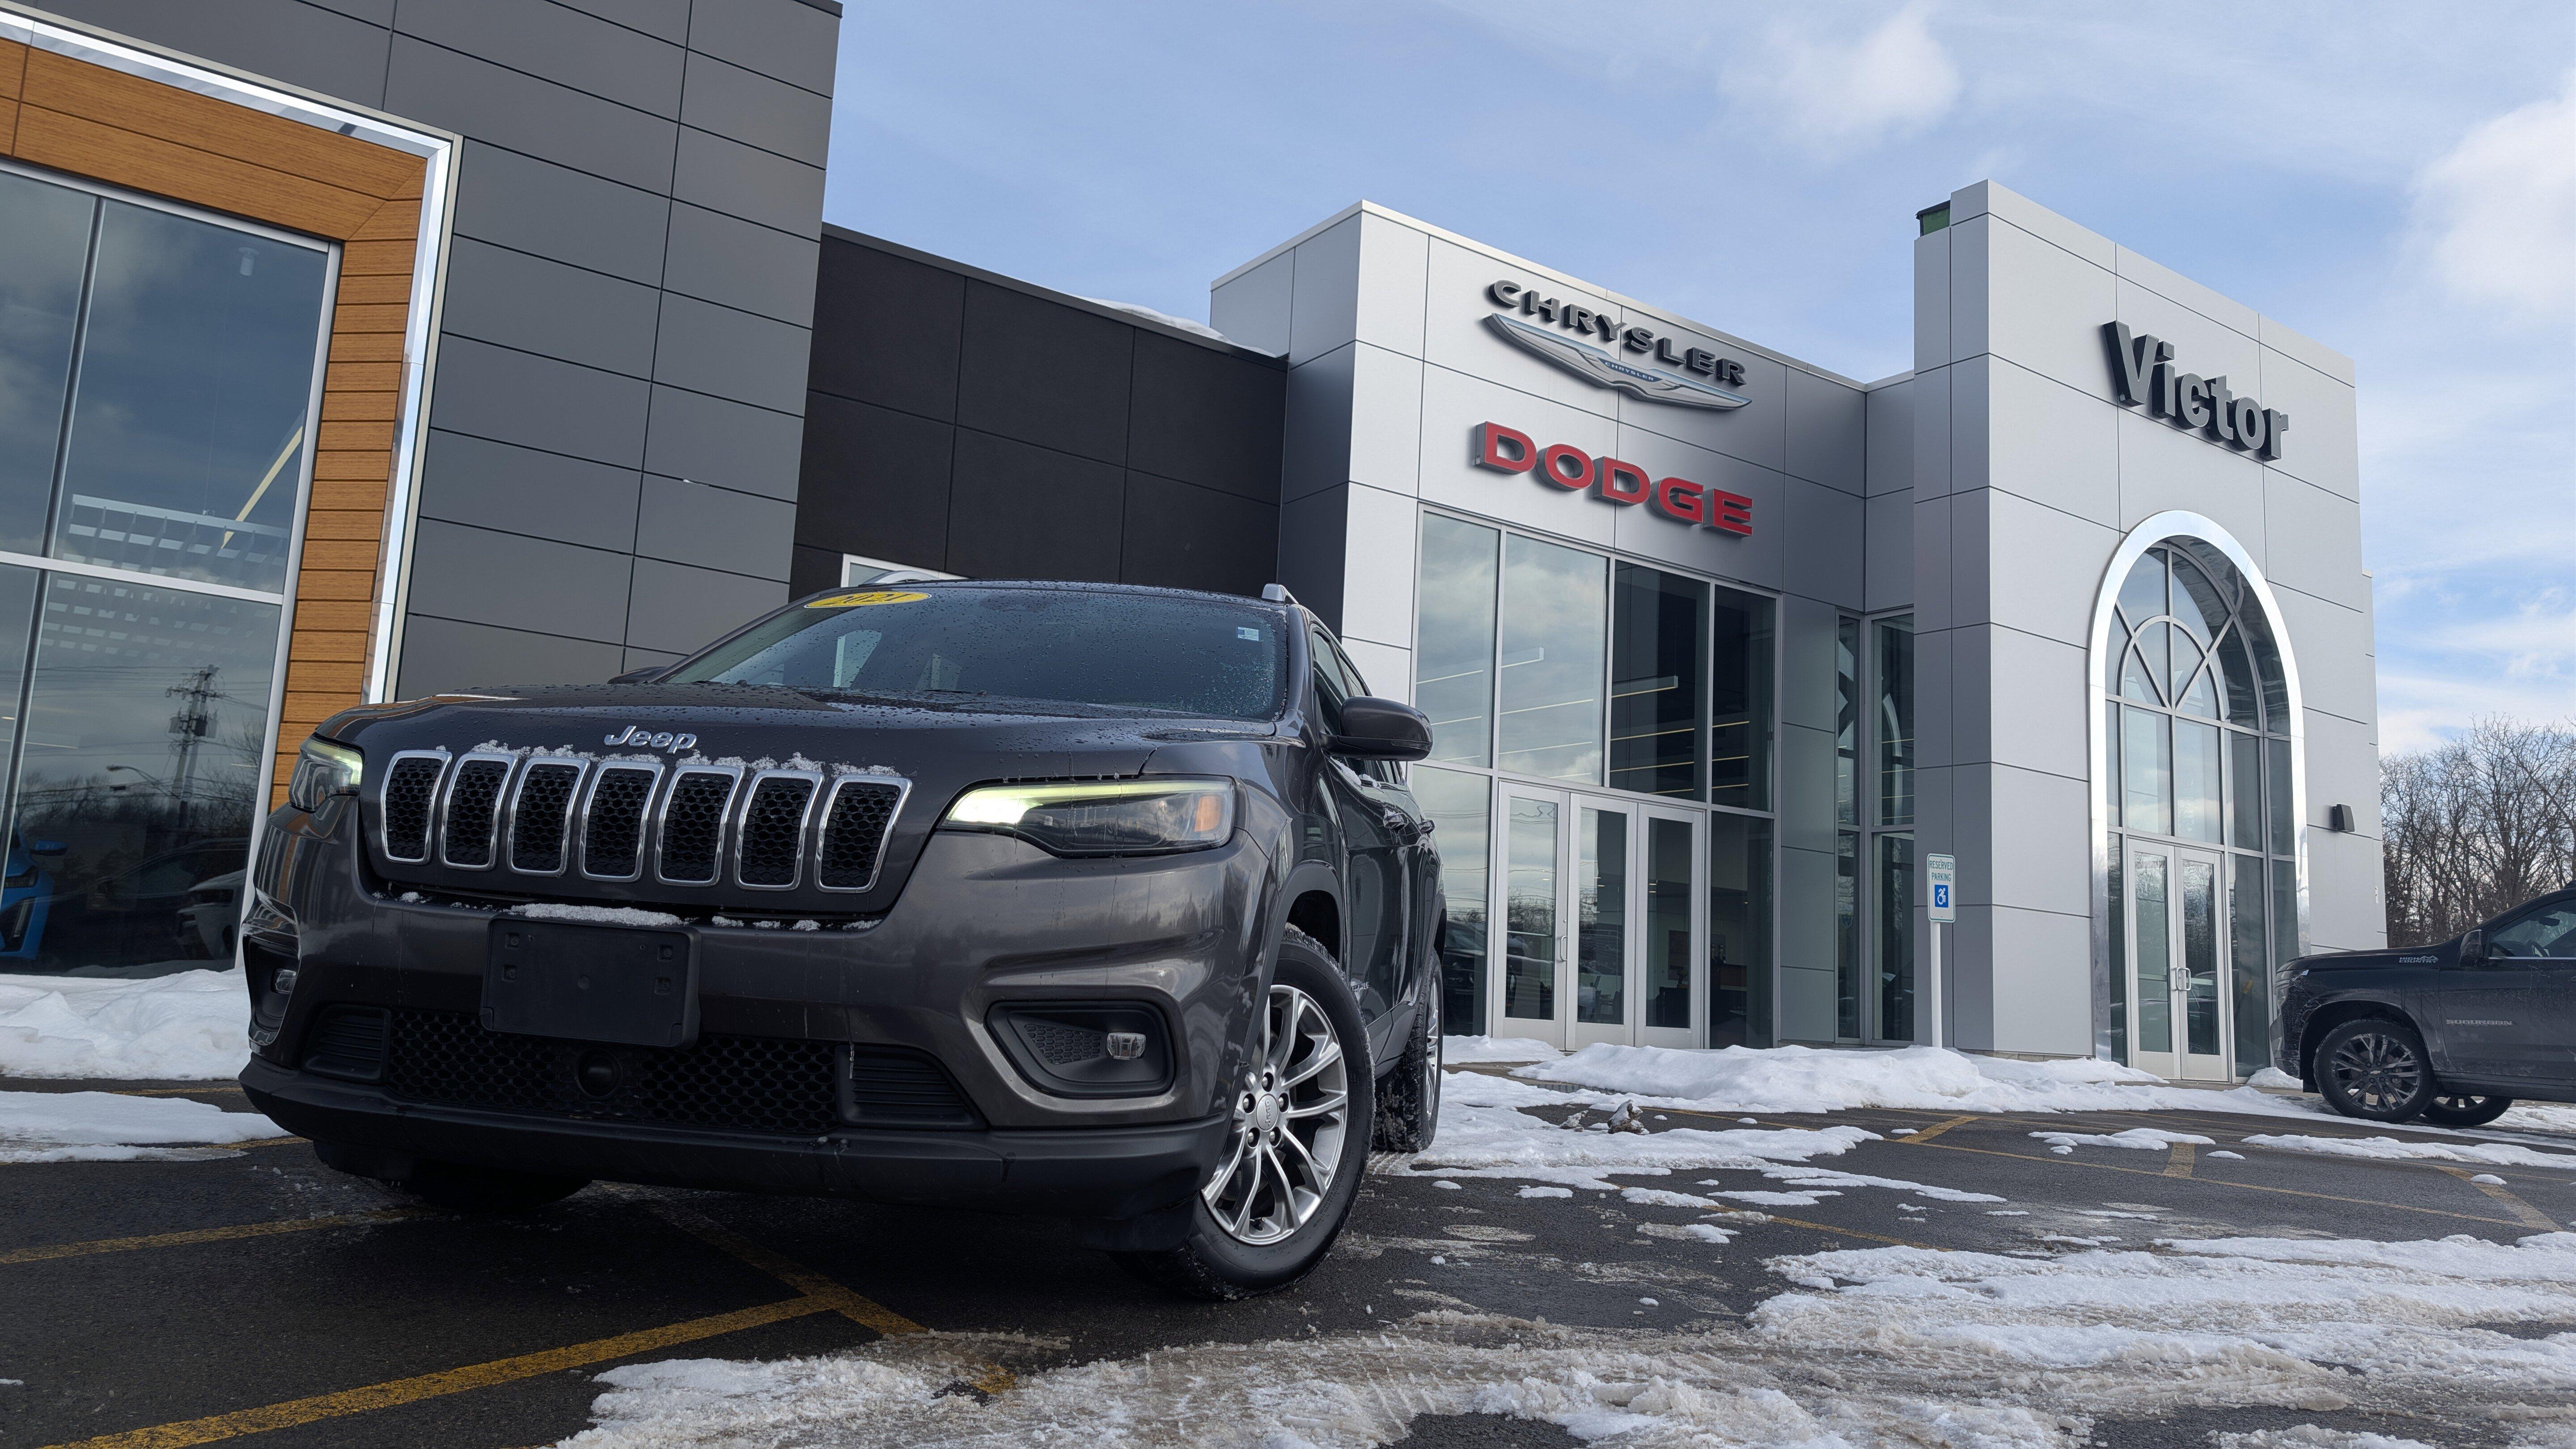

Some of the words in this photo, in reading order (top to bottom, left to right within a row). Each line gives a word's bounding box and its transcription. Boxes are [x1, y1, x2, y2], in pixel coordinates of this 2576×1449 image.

[1488, 280, 1746, 386] CHRYSLER
[1605, 362, 1654, 381] CHRYSLER
[2103, 320, 2288, 461] Victor
[1475, 421, 1753, 537] DODGE
[604, 725, 697, 754] Jeep
[1929, 860, 1953, 870] RESERVED
[1932, 872, 1951, 882] PARKING
